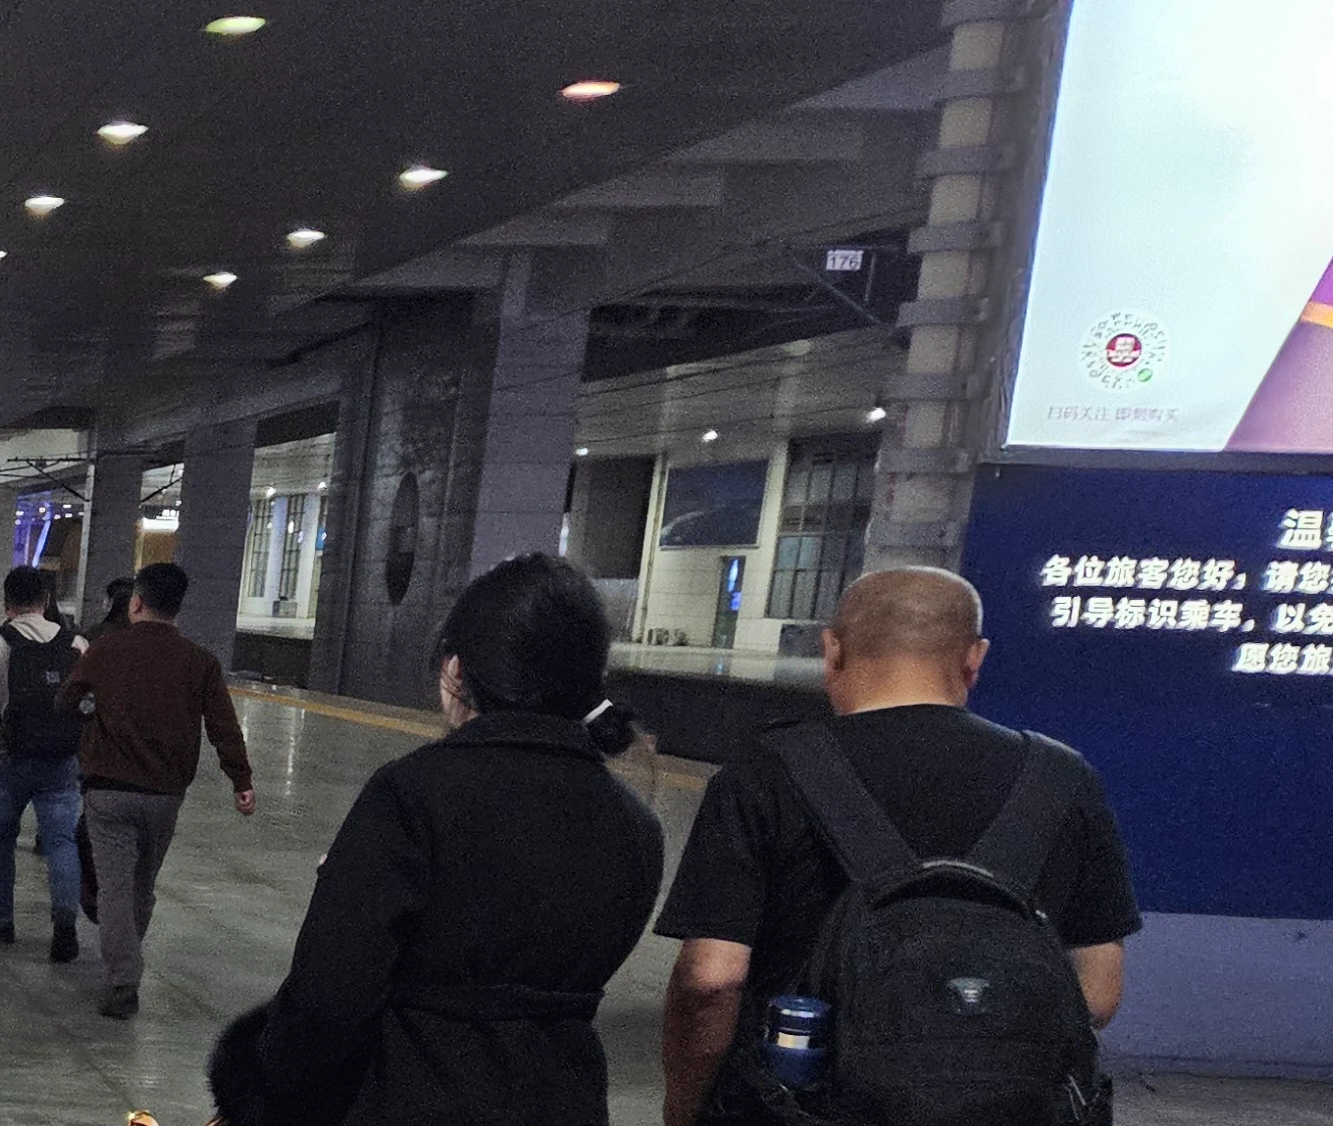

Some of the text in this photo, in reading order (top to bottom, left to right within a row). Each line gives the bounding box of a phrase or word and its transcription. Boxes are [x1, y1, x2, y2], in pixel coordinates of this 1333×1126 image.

[1277, 508, 1333, 551] 温
[1039, 555, 1333, 594] 各位旅客您好，请您
